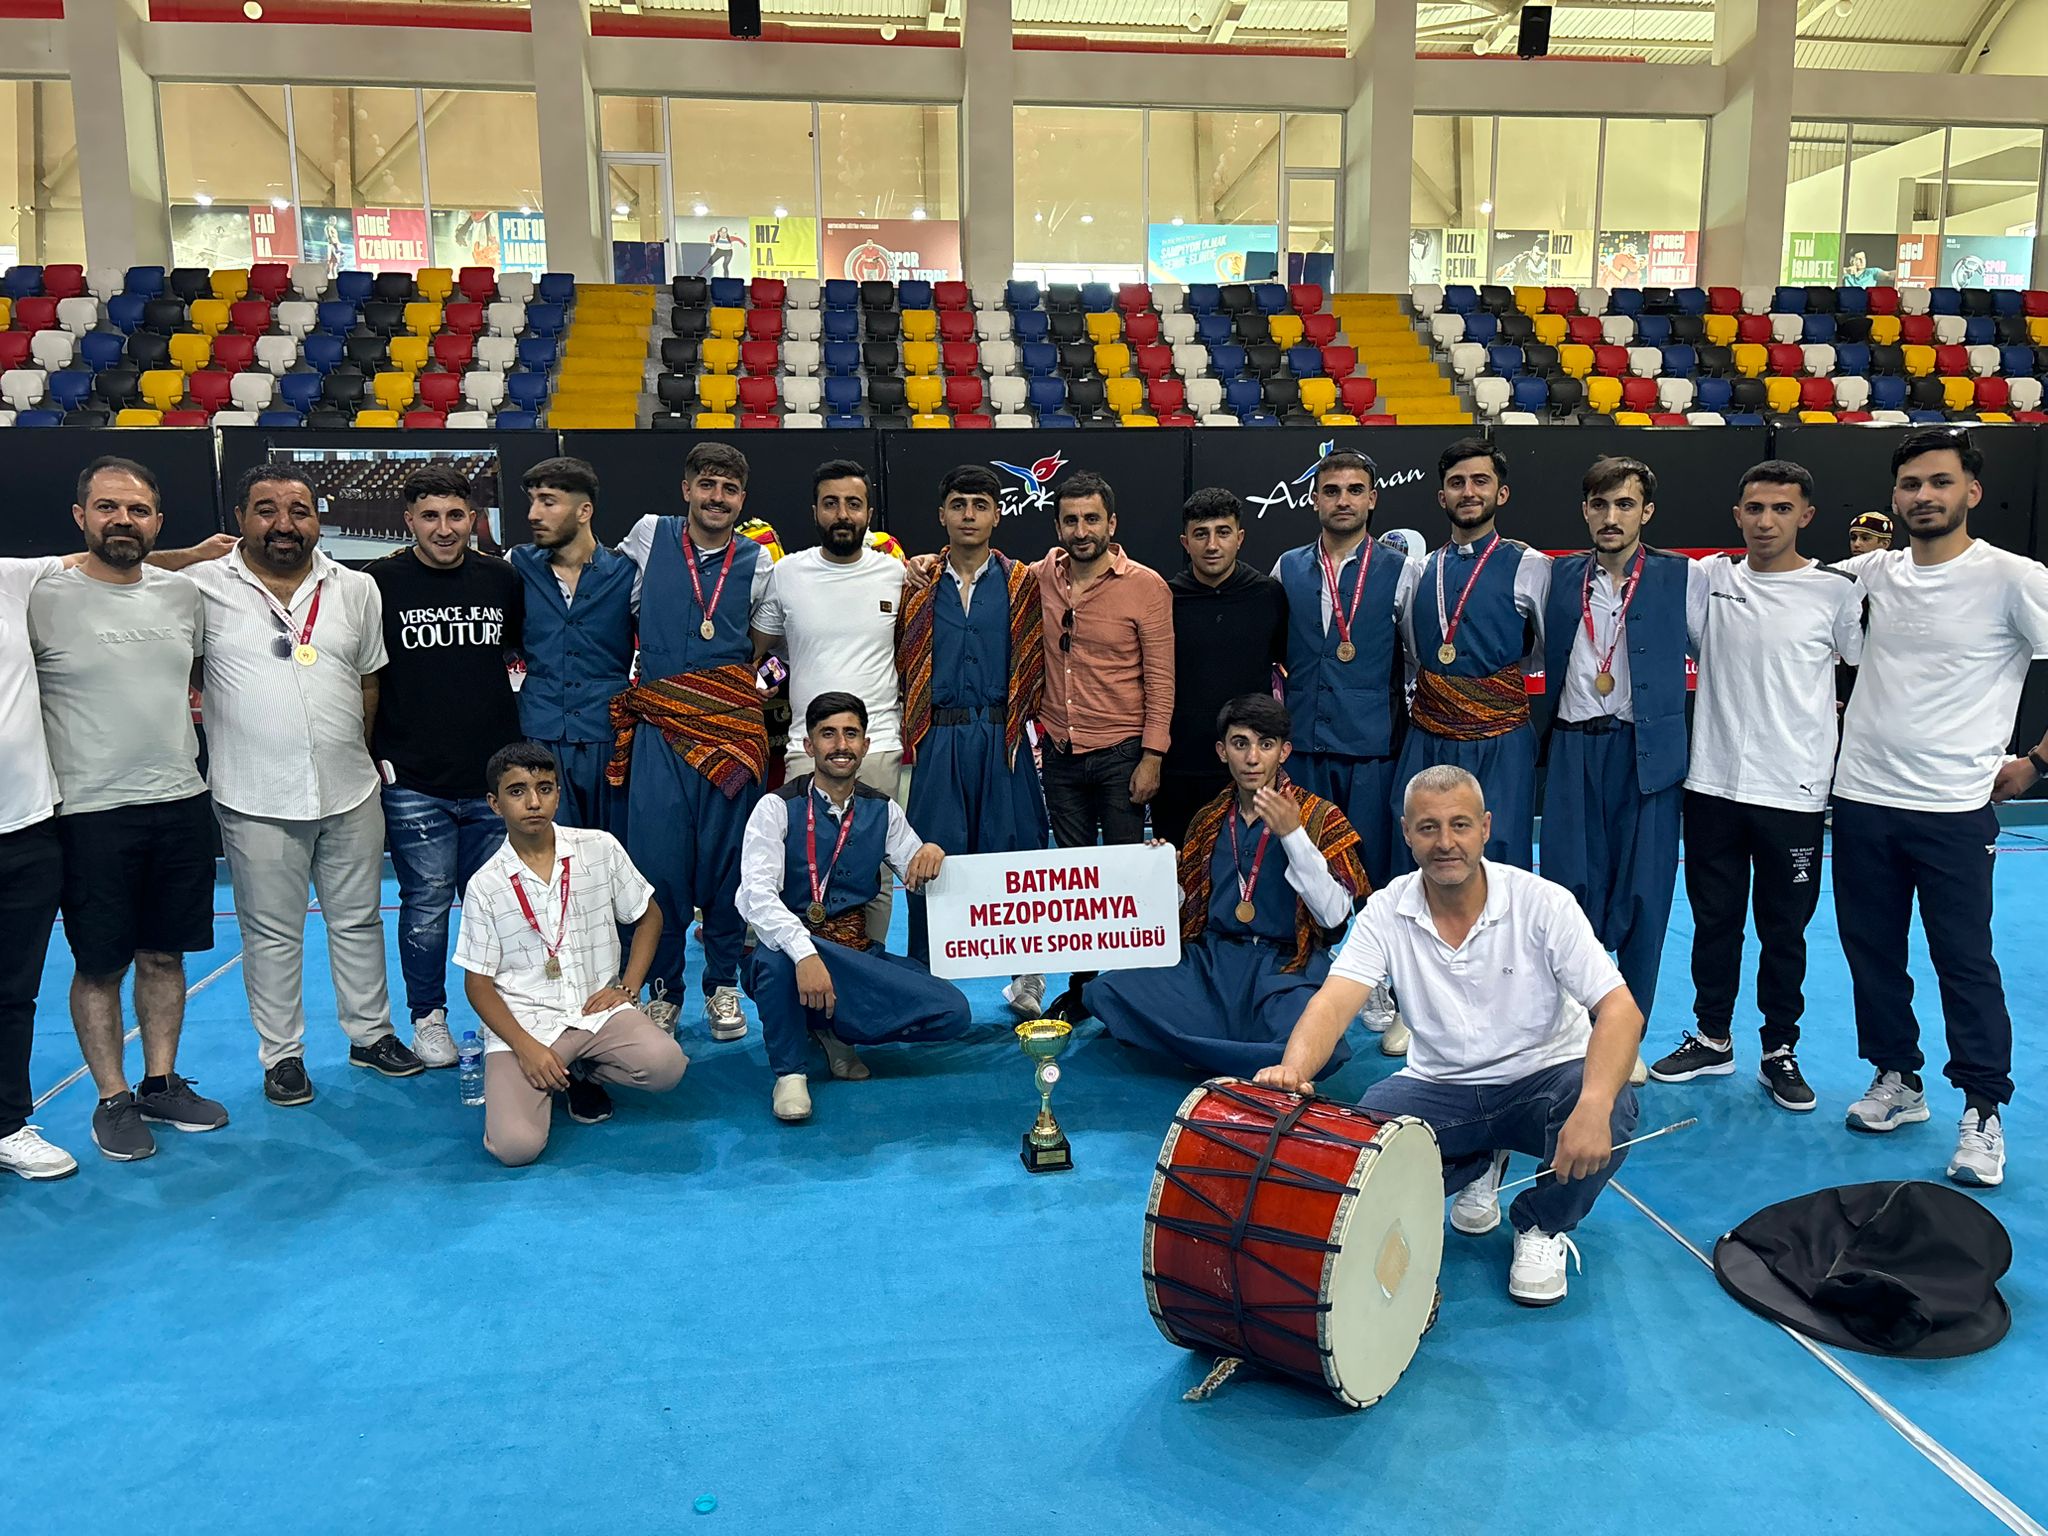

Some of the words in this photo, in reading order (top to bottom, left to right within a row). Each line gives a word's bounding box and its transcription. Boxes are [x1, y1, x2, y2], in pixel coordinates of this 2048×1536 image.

[755, 225, 780, 243] HIZ
[1446, 234, 1475, 253] HIZLI
[756, 248, 775, 266] LA
[1793, 239, 1815, 257] TAM
[887, 251, 920, 268] SPOR
[399, 606, 463, 625] VERSACE
[465, 606, 504, 622] JEANS
[401, 622, 503, 649] COUTURE
[1005, 866, 1099, 894] BATMAN
[969, 895, 1138, 927] MEZOPOTAMYA
[945, 934, 1017, 960] GENÇLİK
[1021, 936, 1043, 954] VE
[1047, 933, 1093, 952] SPOR
[1097, 926, 1166, 949] KULÜBÜ
